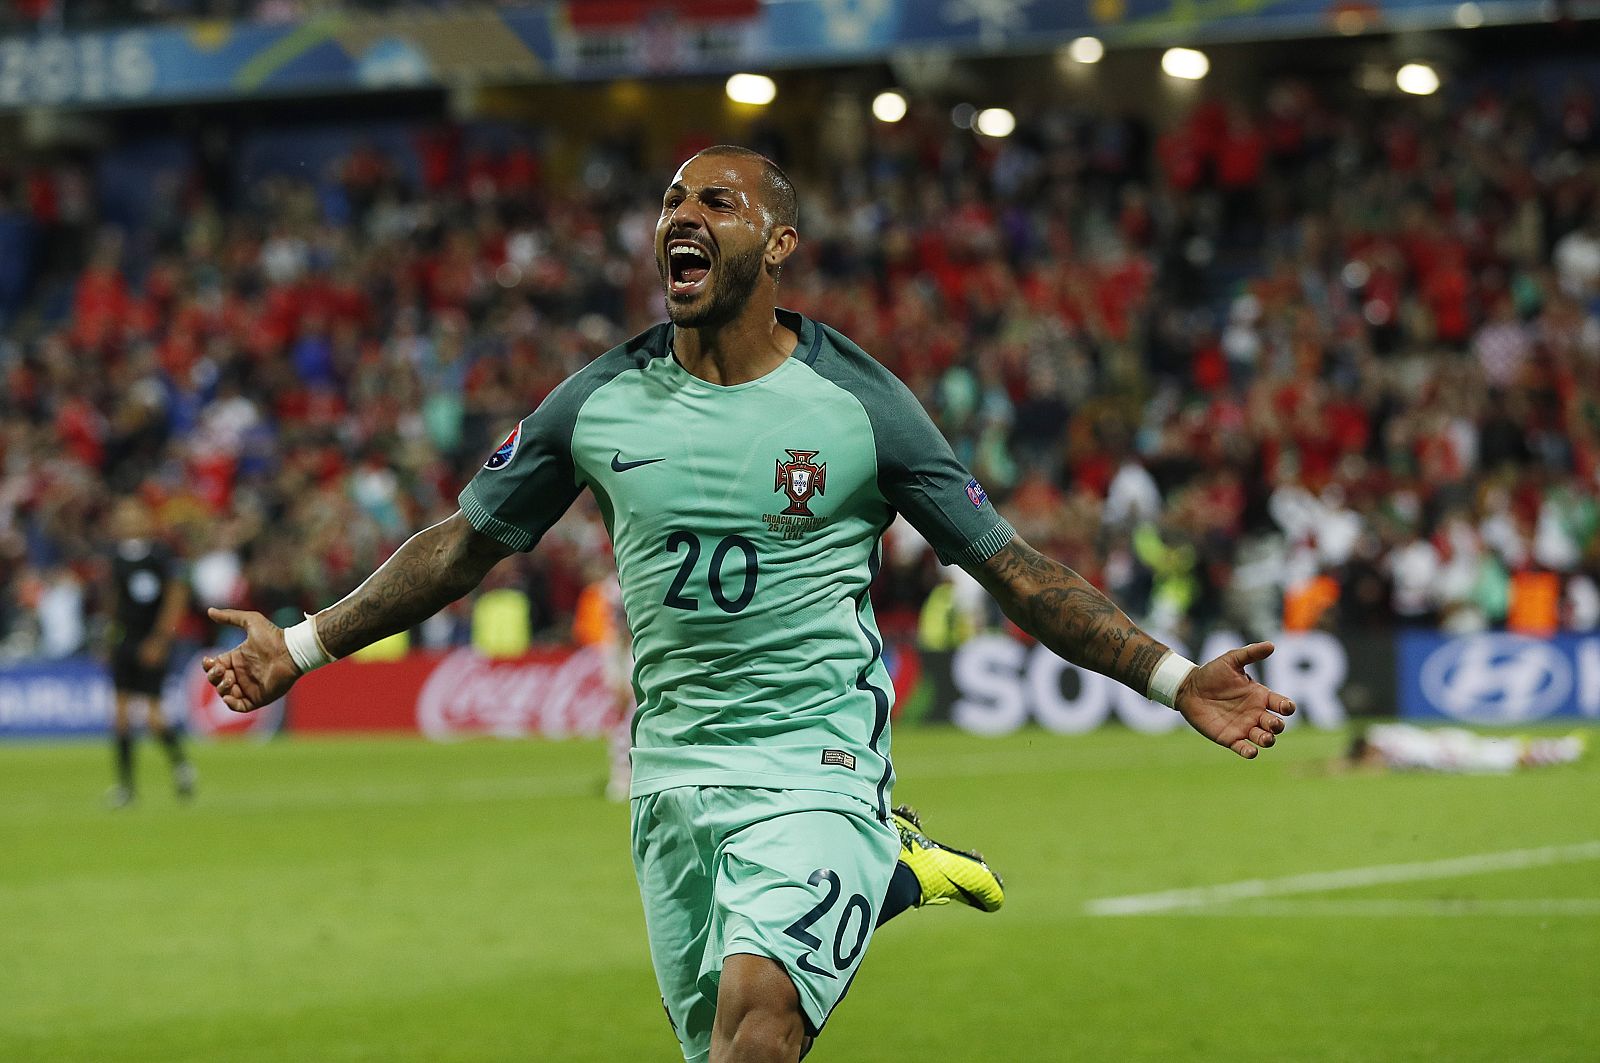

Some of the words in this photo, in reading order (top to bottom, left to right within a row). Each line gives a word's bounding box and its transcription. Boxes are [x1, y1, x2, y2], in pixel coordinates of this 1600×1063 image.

[663, 530, 758, 614] 20
[783, 532, 804, 541] LENS
[783, 868, 871, 971] 20
